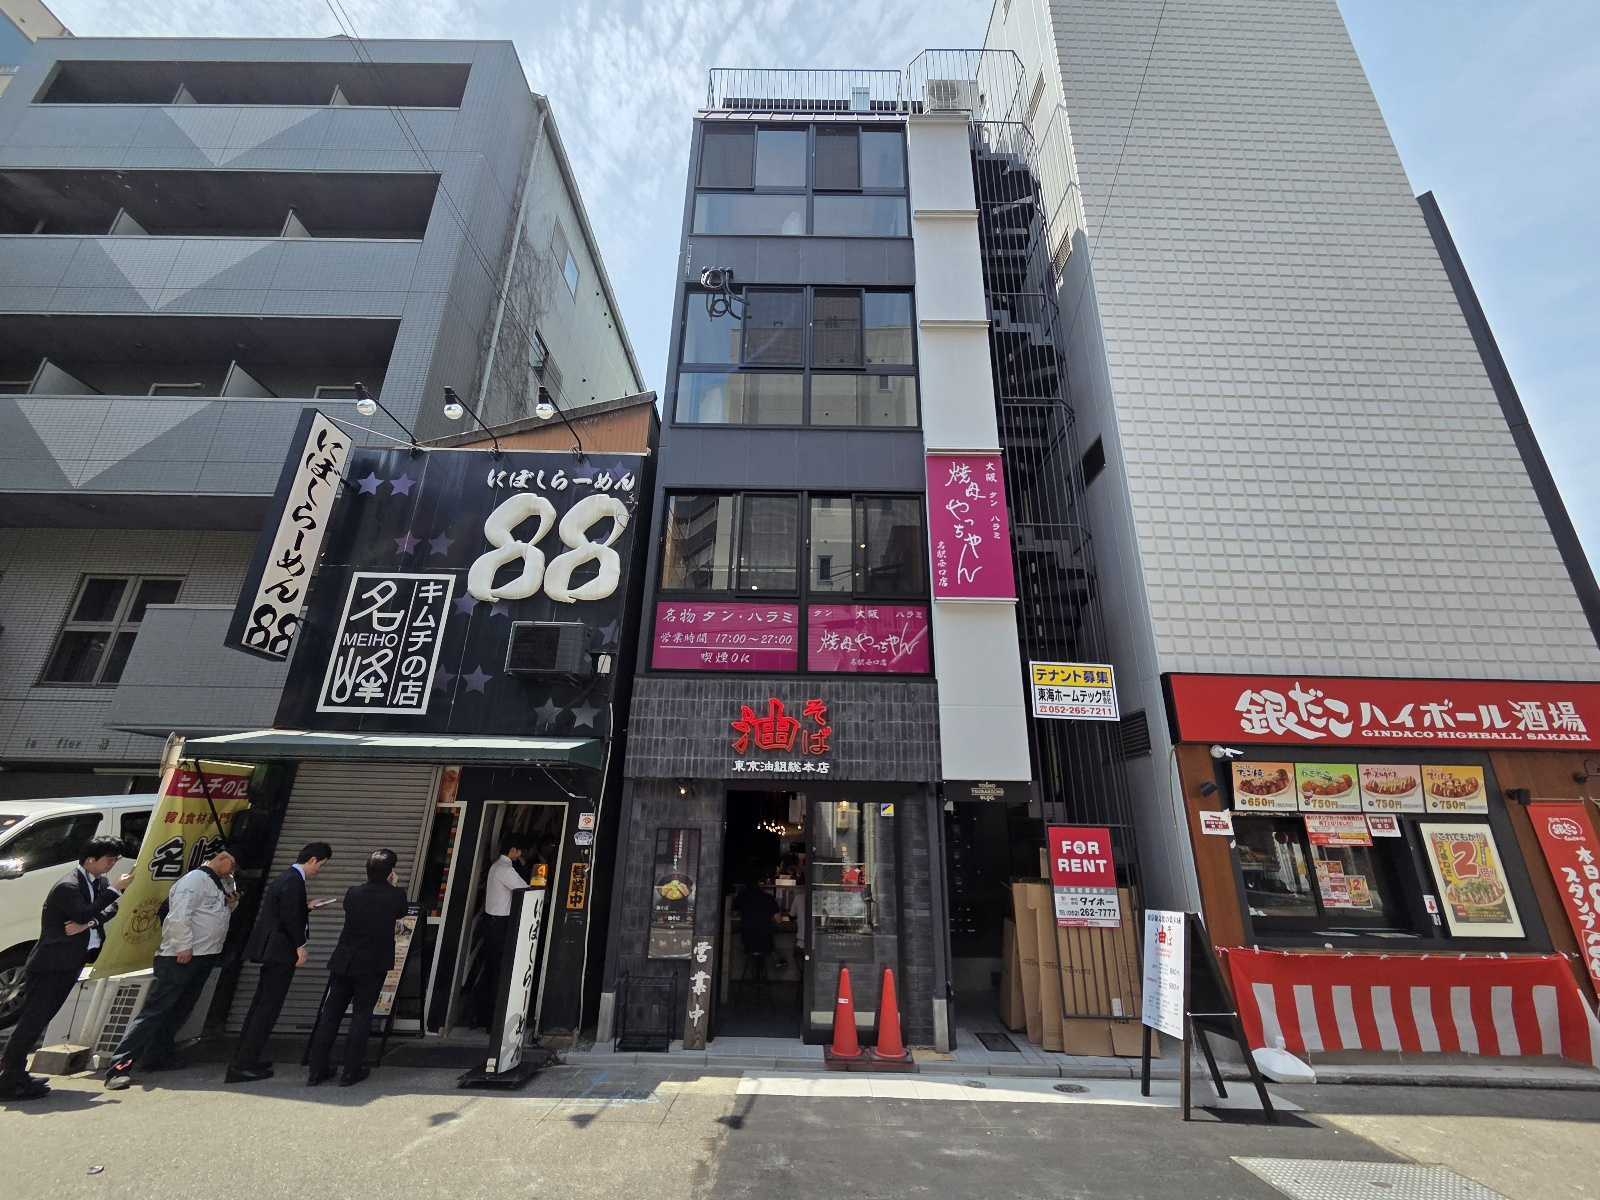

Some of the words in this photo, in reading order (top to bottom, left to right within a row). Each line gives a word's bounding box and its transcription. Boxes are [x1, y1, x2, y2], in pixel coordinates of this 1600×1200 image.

[487, 468, 636, 491] にぼしらーめん
[985, 462, 997, 482] 大阪
[989, 492, 998, 507] タン
[991, 515, 1001, 539] ハラミ
[467, 492, 634, 604] 88
[664, 608, 696, 624] 名物
[814, 609, 832, 617] タン
[856, 609, 880, 619] 大阪
[896, 611, 923, 619] ハラミ
[343, 633, 399, 647] MEIHO
[393, 582, 443, 705] キムチの店
[660, 632, 707, 644] 営業時間
[1036, 669, 1109, 684] テナント募集
[1037, 688, 1102, 704] 東海ホームテック
[1235, 681, 1354, 740] 銀だこ
[1362, 729, 1434, 740] GINDACO
[1437, 731, 1522, 741] HIGHBALL
[1526, 732, 1592, 742] SAKABA
[732, 760, 831, 774] 東京油組総本店
[1248, 798, 1275, 808] 650円
[1311, 799, 1338, 809] 750円
[1375, 799, 1402, 809] 750円
[1439, 800, 1466, 810] 750円
[1061, 840, 1100, 855] FOR
[1057, 858, 1107, 873] RENT
[1450, 840, 1479, 878] 2
[1079, 897, 1115, 906] タイホー
[1561, 866, 1596, 929] スタンプ
[1080, 908, 1116, 918] 262-7777
[688, 941, 712, 1028] 営業中
